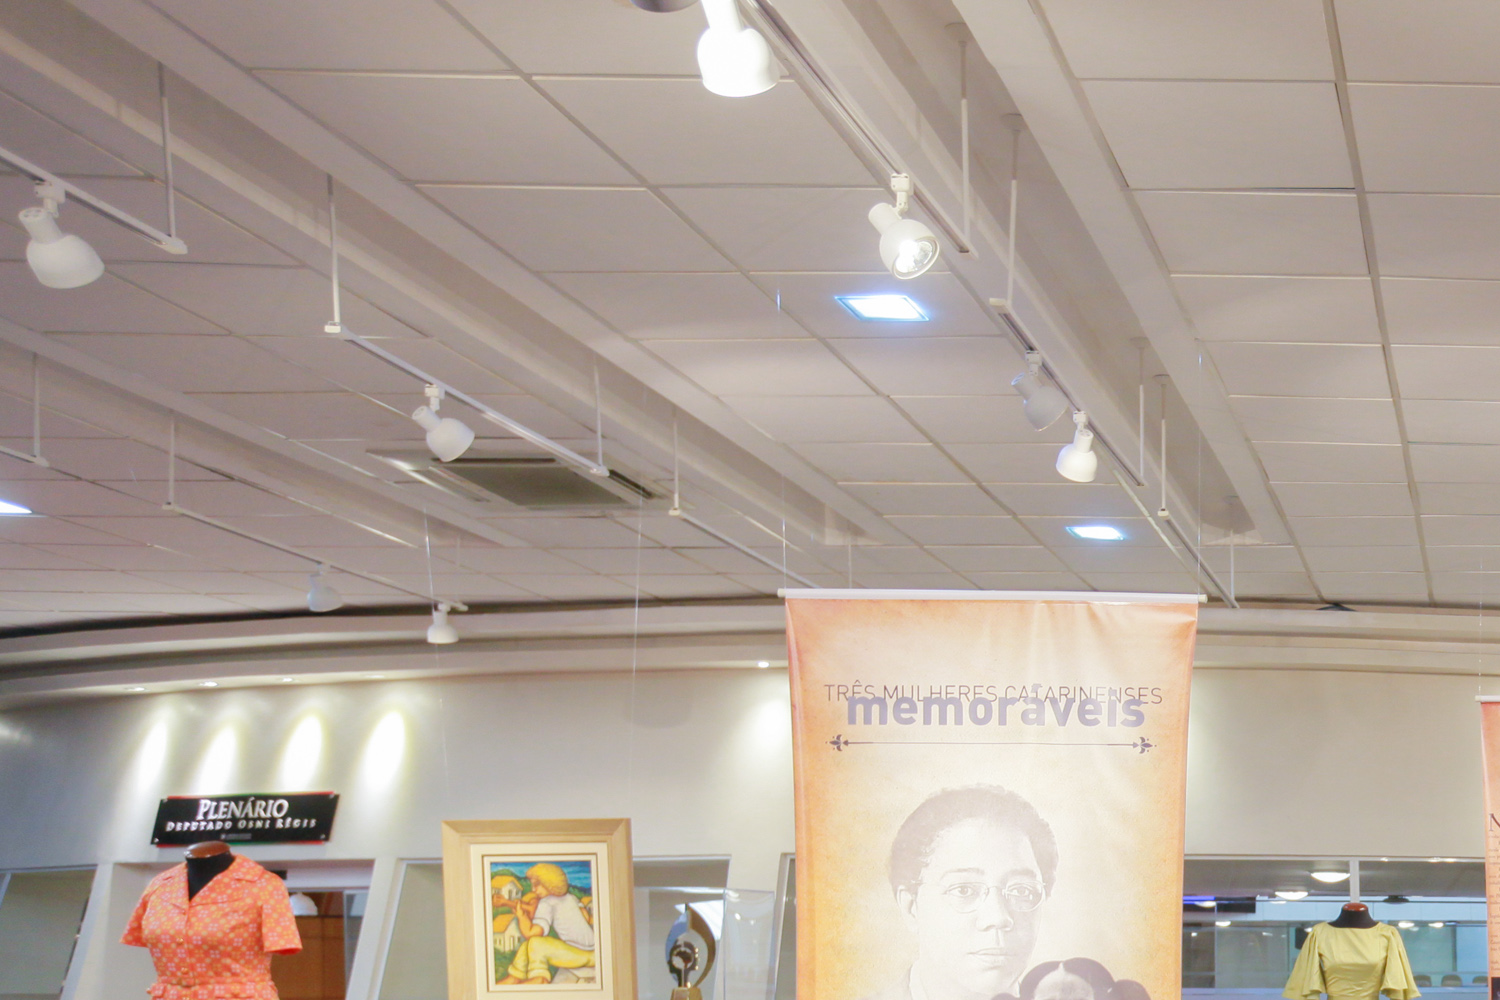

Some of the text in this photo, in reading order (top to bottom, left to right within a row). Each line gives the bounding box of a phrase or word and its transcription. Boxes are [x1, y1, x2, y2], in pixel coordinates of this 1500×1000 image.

[824, 679, 875, 701] TRÊS
[884, 685, 998, 702] MULHERES
[847, 683, 1145, 727] memoráveis
[195, 796, 289, 820] PLENÁRIO
[165, 817, 317, 831] DEPUTADO OSNI RÉGIS
